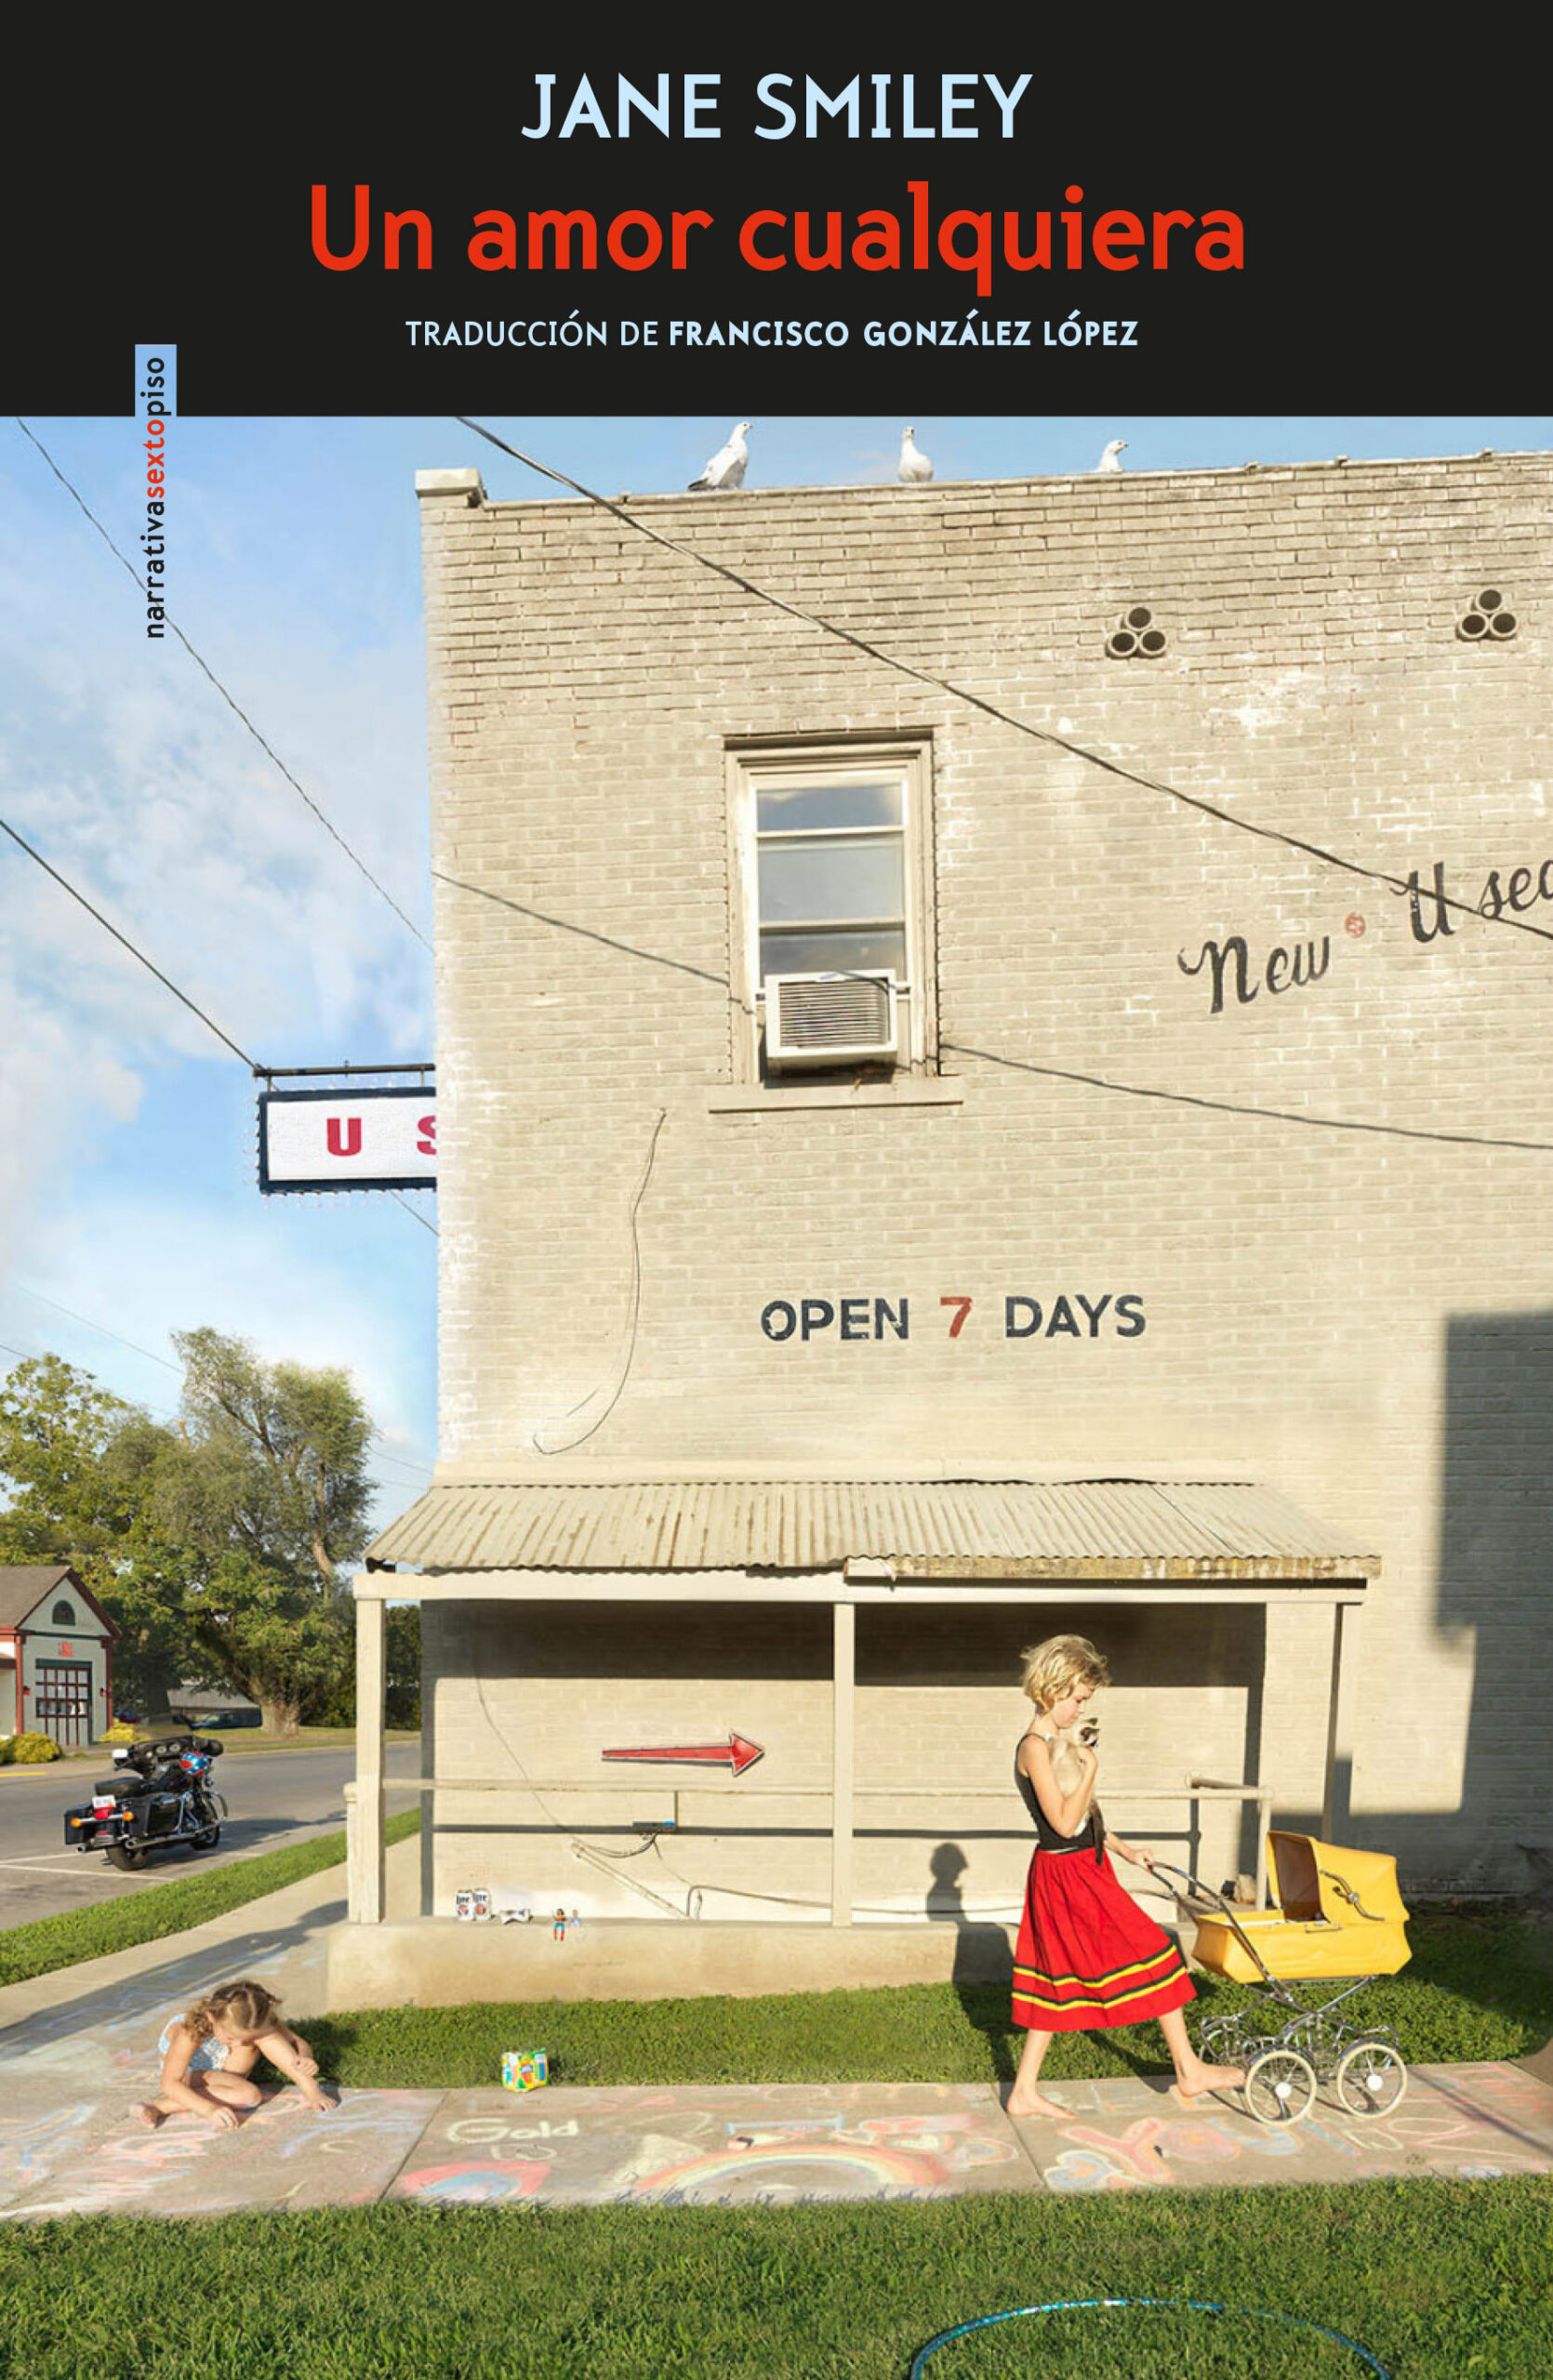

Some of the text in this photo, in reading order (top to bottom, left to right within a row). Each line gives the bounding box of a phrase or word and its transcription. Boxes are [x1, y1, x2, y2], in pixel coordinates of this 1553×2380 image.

[761, 1295, 1147, 1342] OPEN 7 DAYS
[446, 2117, 579, 2144] Gold
